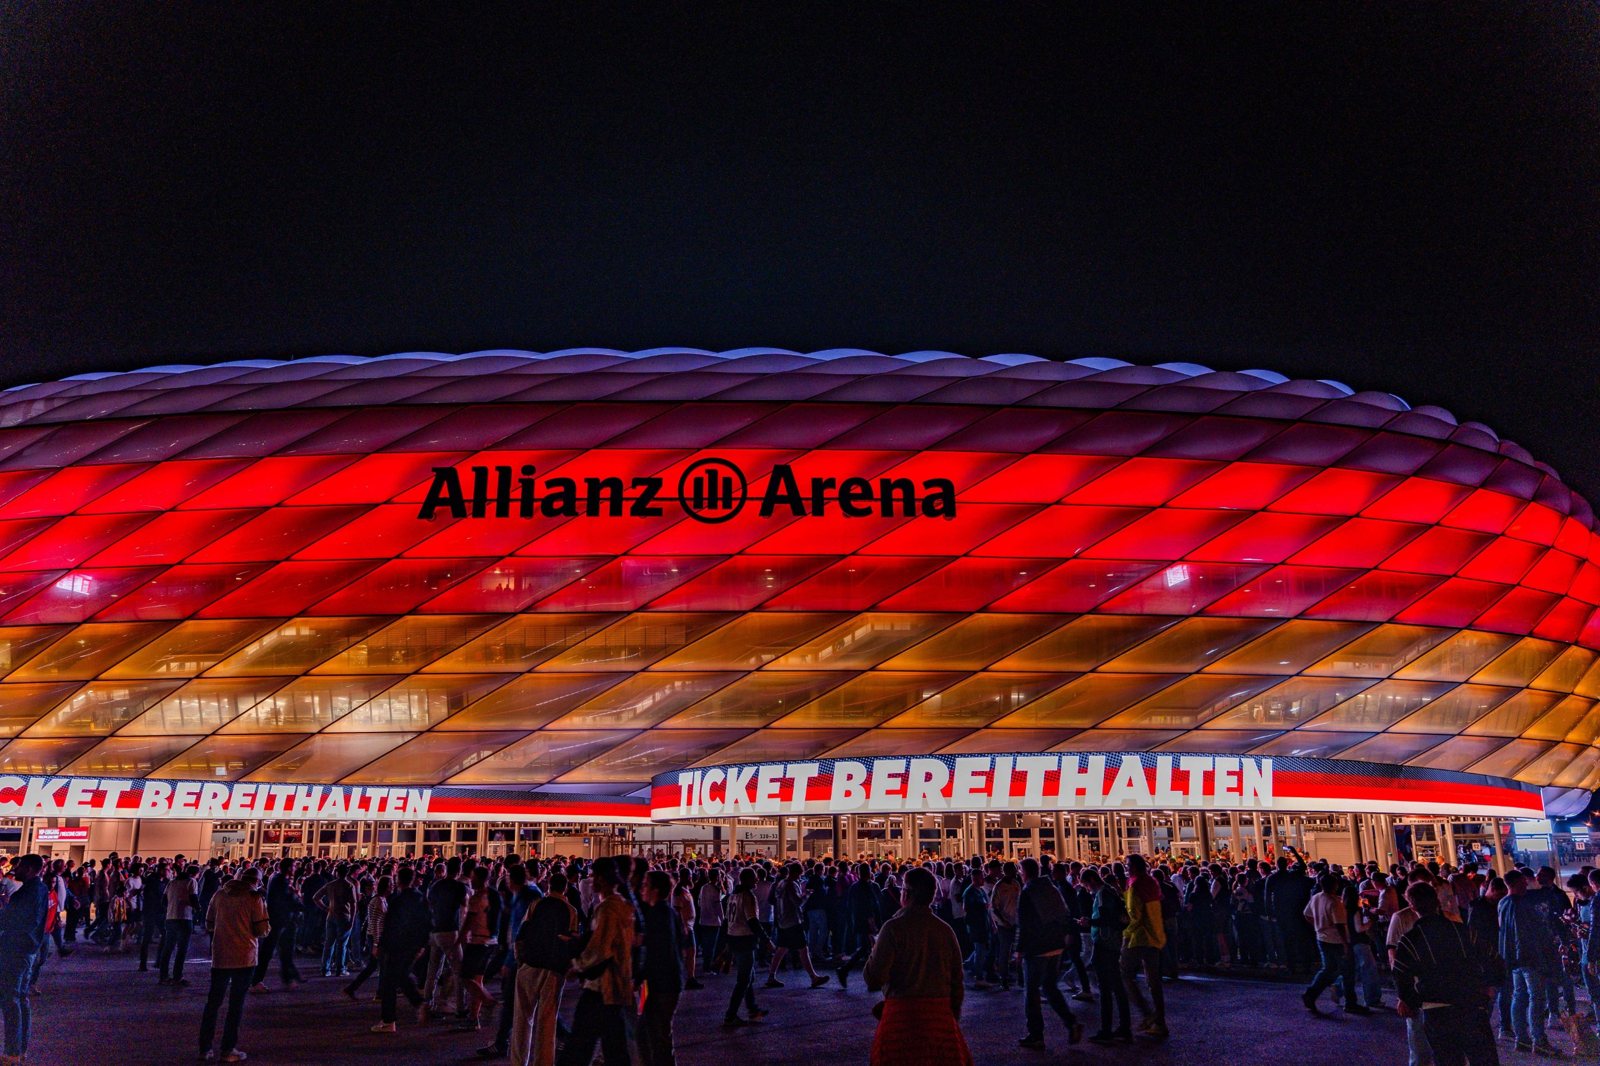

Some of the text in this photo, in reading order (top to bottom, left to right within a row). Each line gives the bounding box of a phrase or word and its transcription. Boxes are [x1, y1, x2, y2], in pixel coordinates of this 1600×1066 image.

[417, 464, 957, 519] Allianz Arena
[0, 776, 432, 819] CKET BEREITHALTEN
[678, 755, 1273, 816] TICKET BEREITHALTEN
